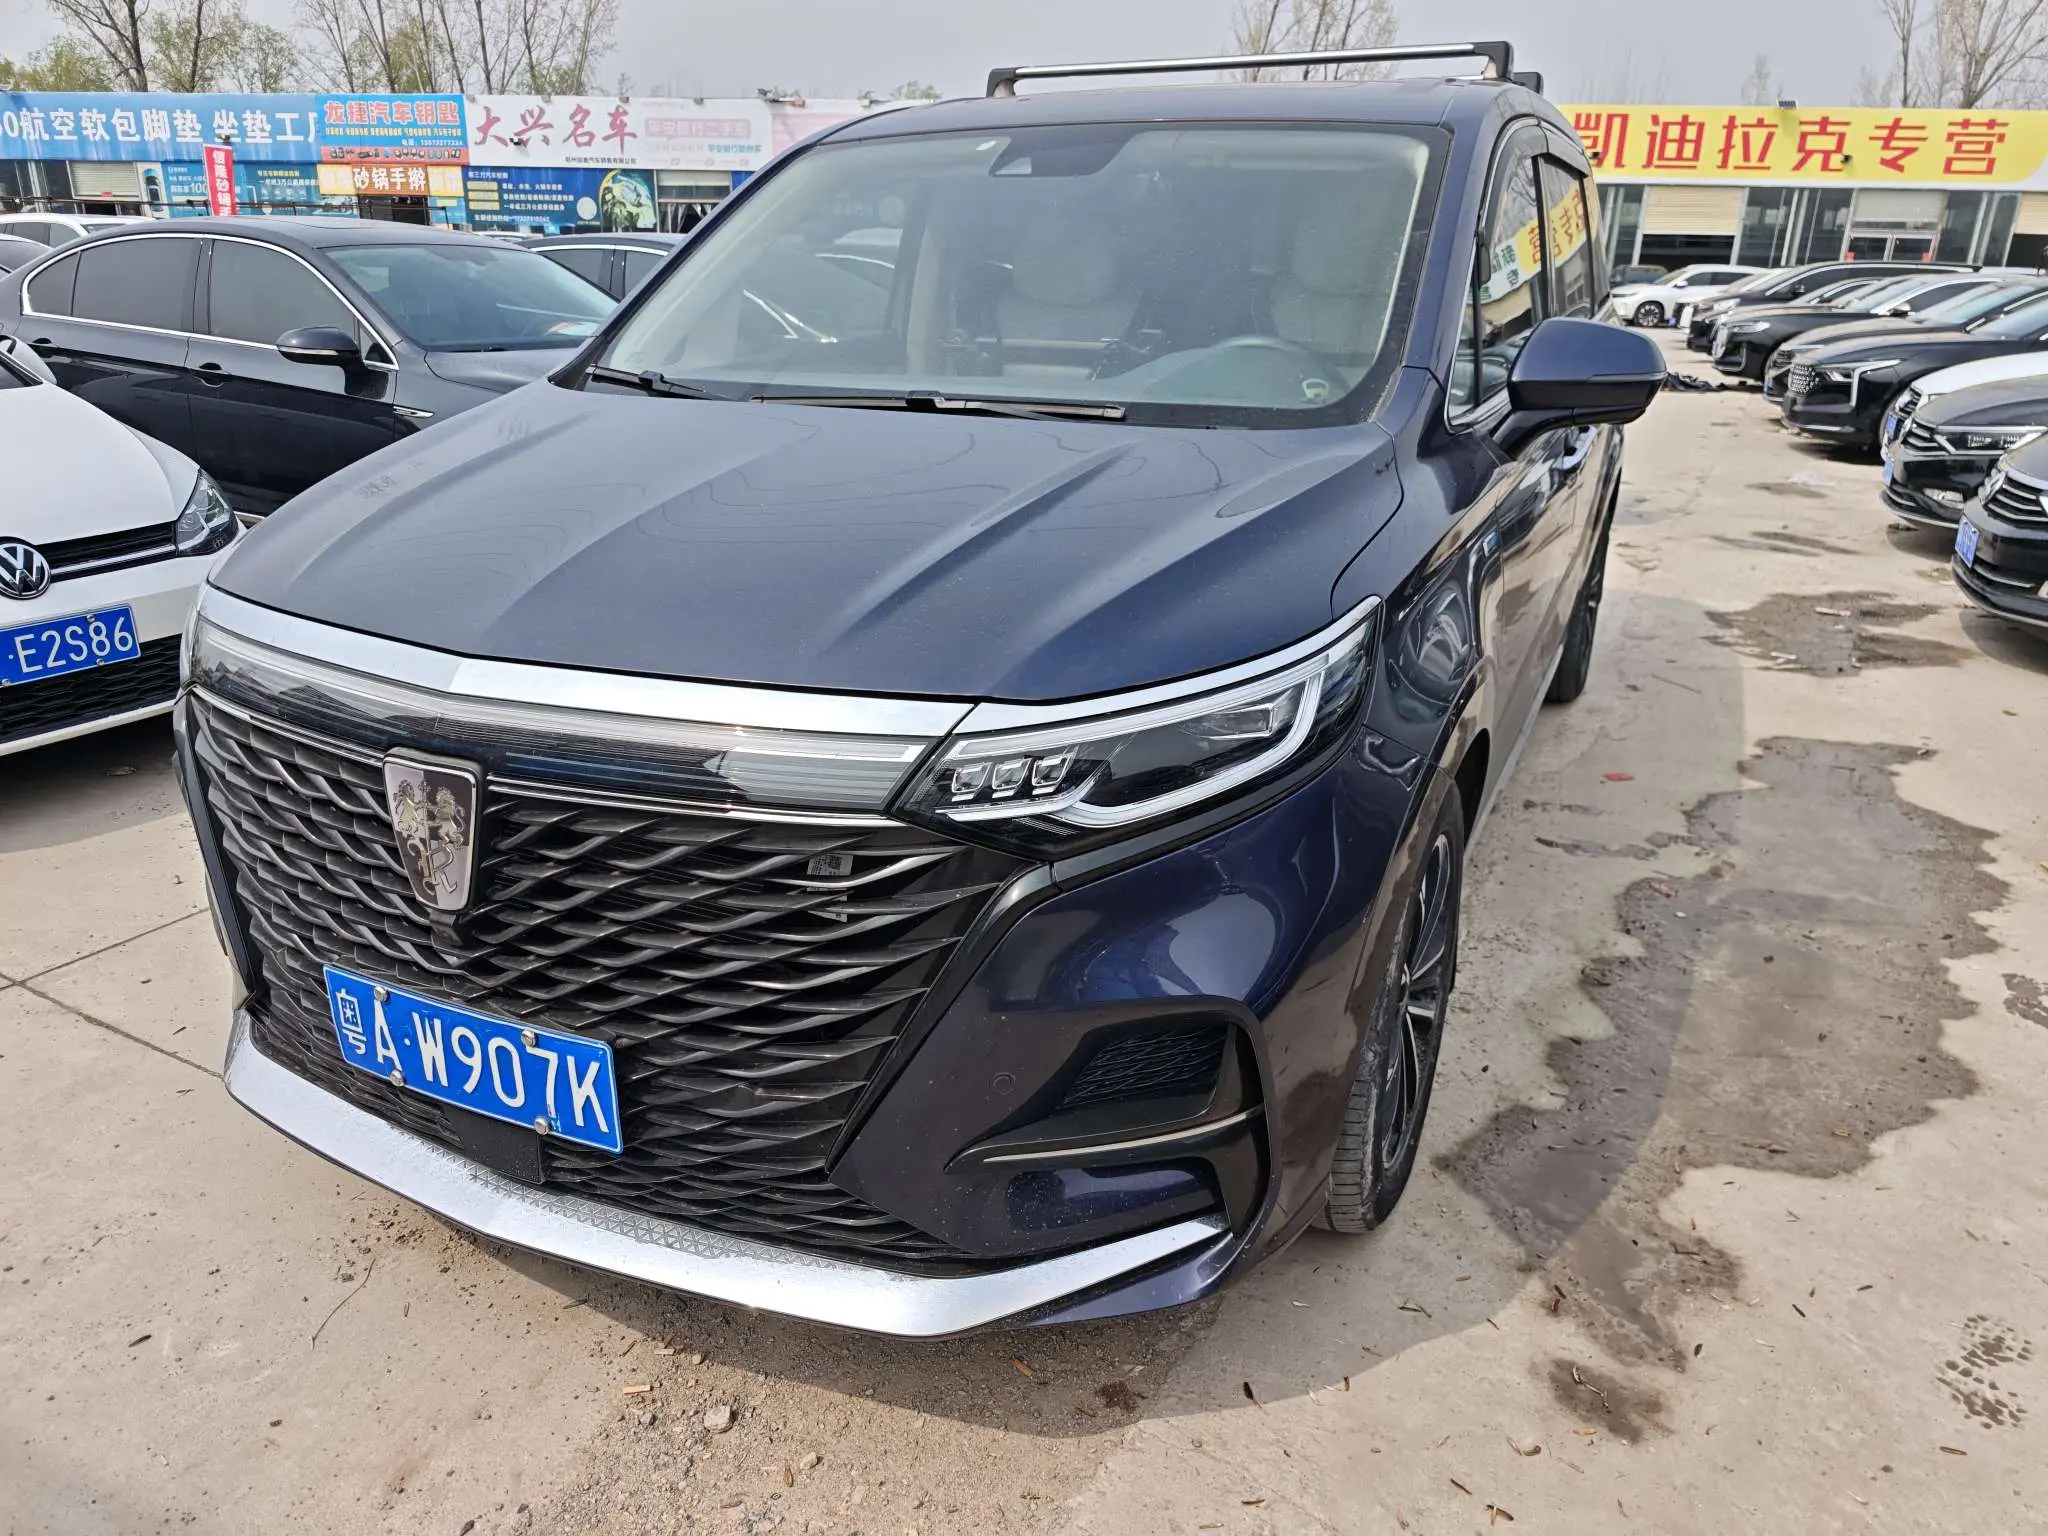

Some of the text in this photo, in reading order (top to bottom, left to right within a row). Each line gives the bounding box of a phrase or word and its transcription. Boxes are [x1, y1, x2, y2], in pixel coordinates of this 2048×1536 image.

[0, 107, 203, 143] 0航空软包脚垫
[325, 100, 459, 124] 龙捷汽车钥匙
[474, 103, 637, 155] 大兴名车
[1574, 112, 2009, 176] 凯迪拉克专营
[352, 166, 427, 191] 砂锅手擀
